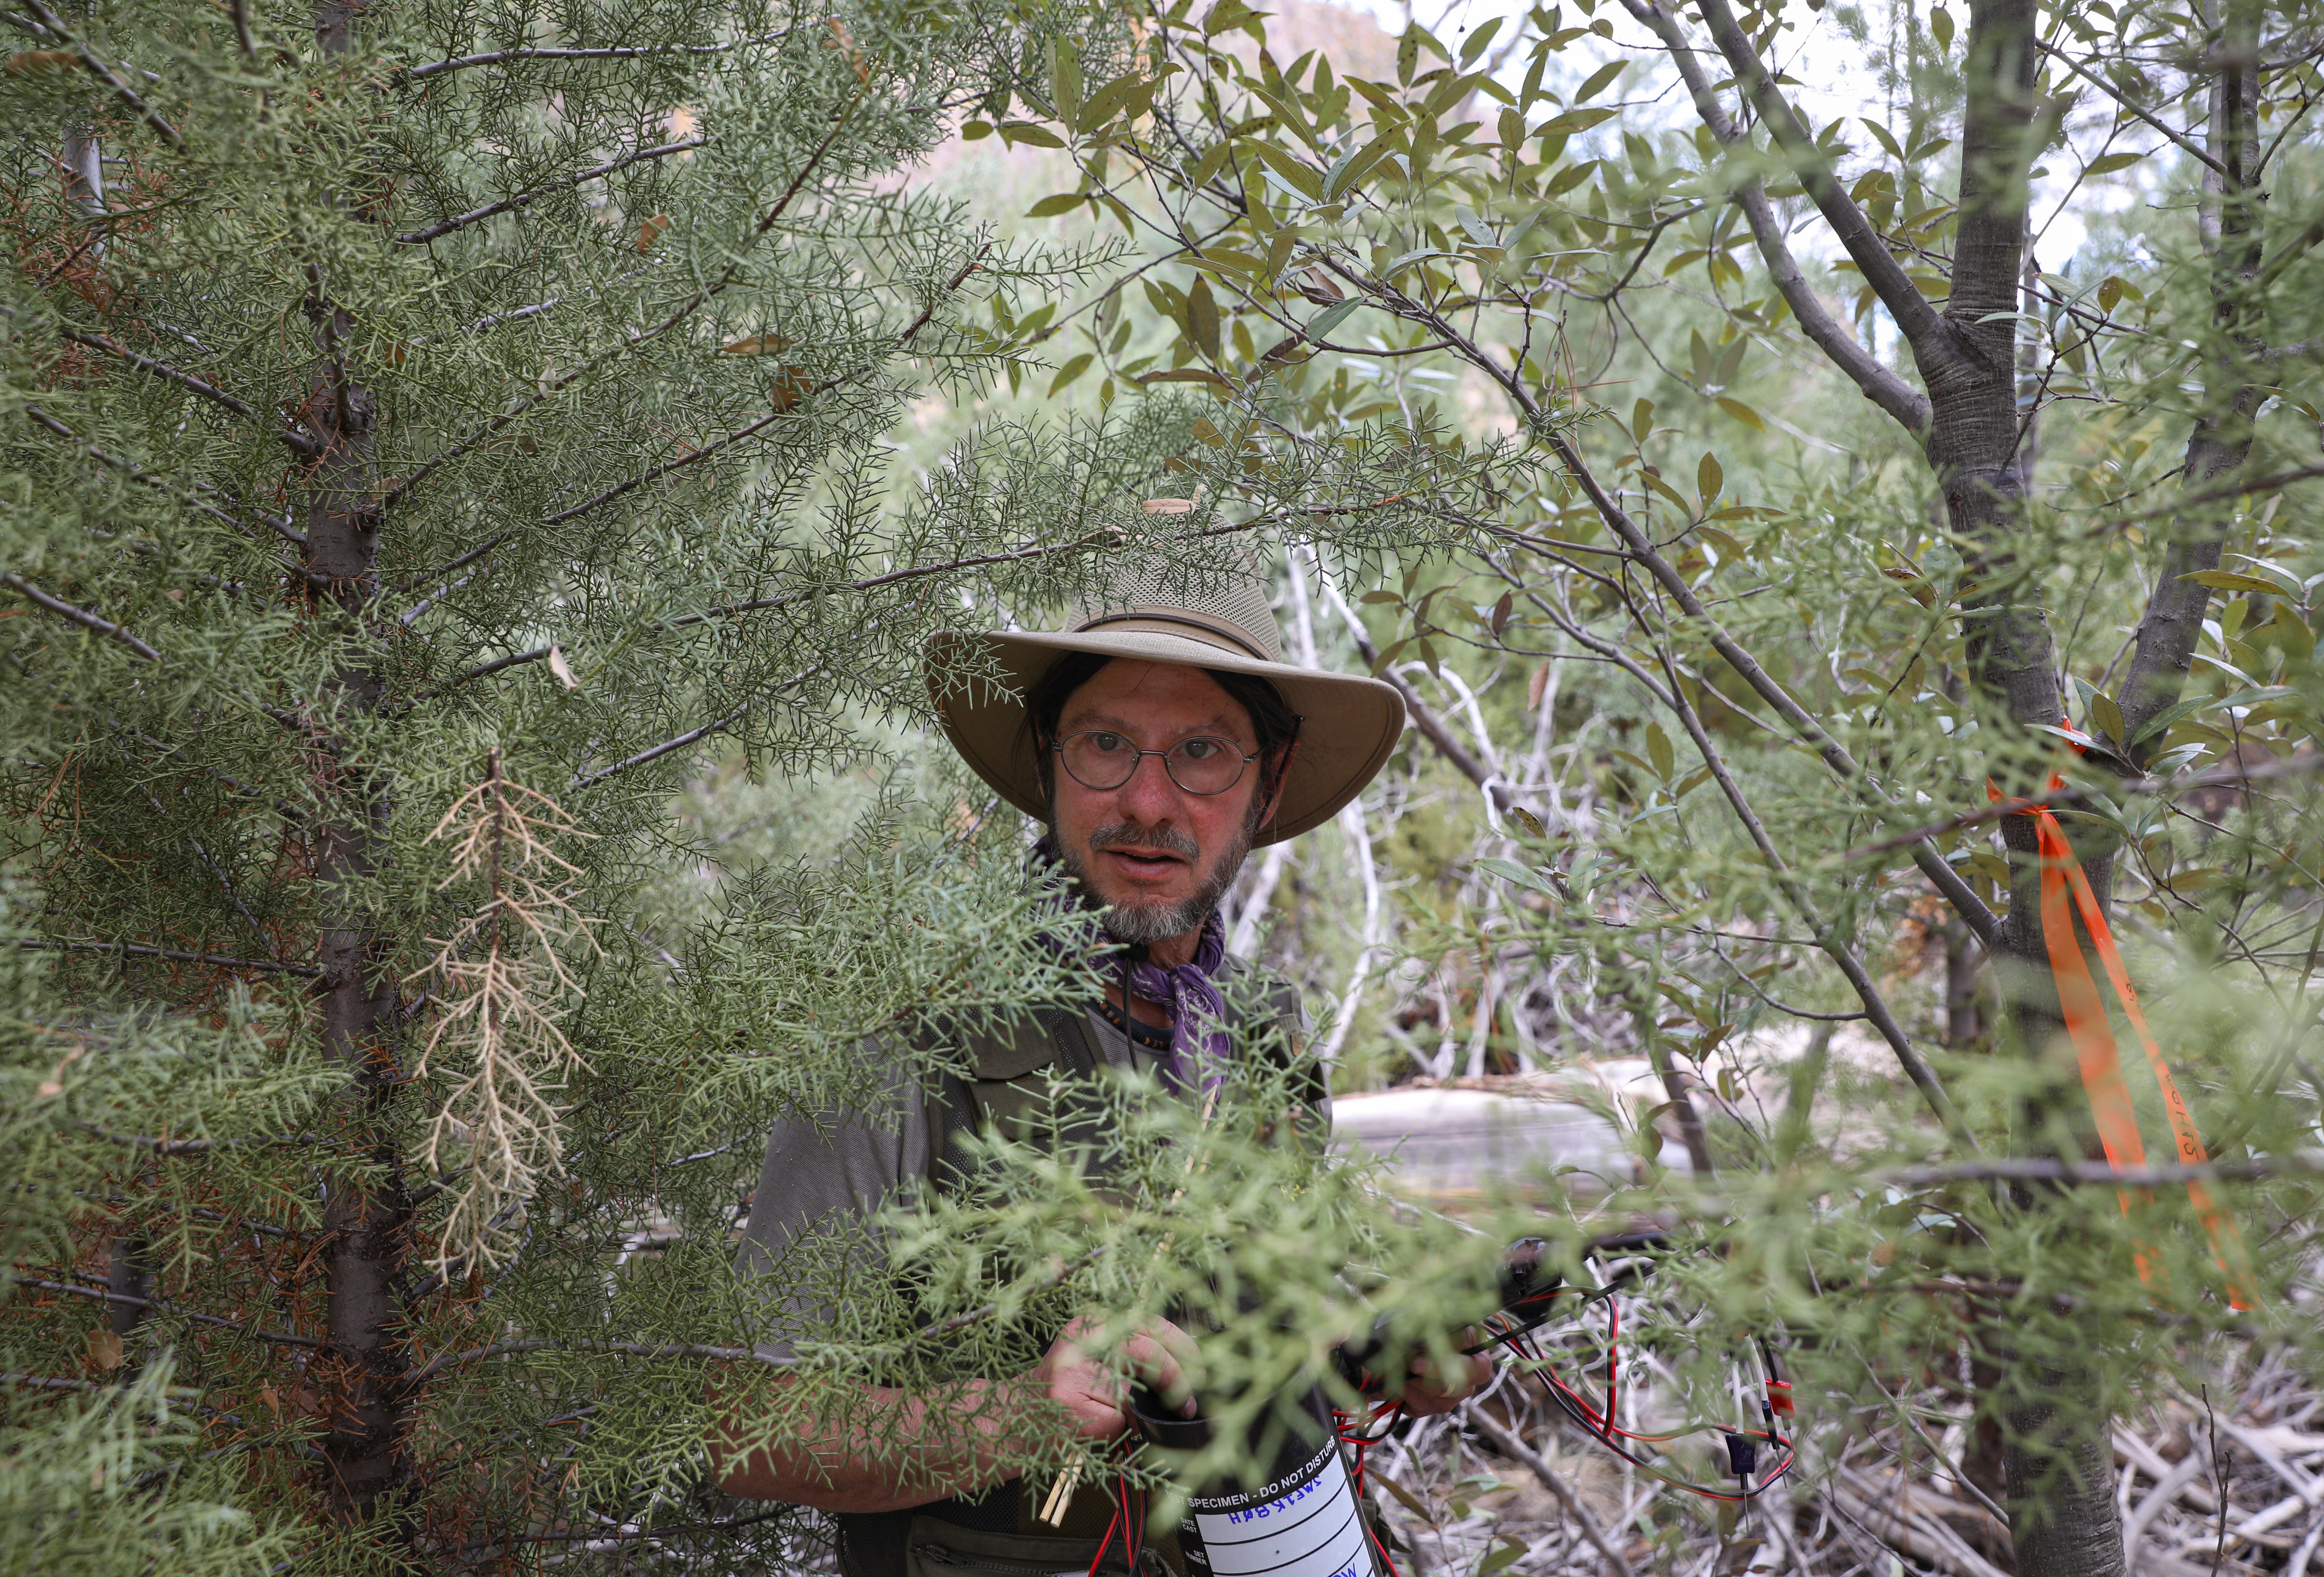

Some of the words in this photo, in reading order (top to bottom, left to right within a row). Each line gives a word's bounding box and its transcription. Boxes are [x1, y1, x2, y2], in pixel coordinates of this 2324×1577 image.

[1165, 1489, 1184, 1505] TEST
[1187, 1493, 1249, 1508] SPECIMEN
[1259, 1483, 1279, 1498] DO
[1281, 1467, 1303, 1488] NOT
[1306, 1435, 1335, 1474] DISTURB
[1180, 1516, 1196, 1527] DATE
[1183, 1524, 1197, 1533] CAST
[1185, 1551, 1207, 1565] NUMBER
